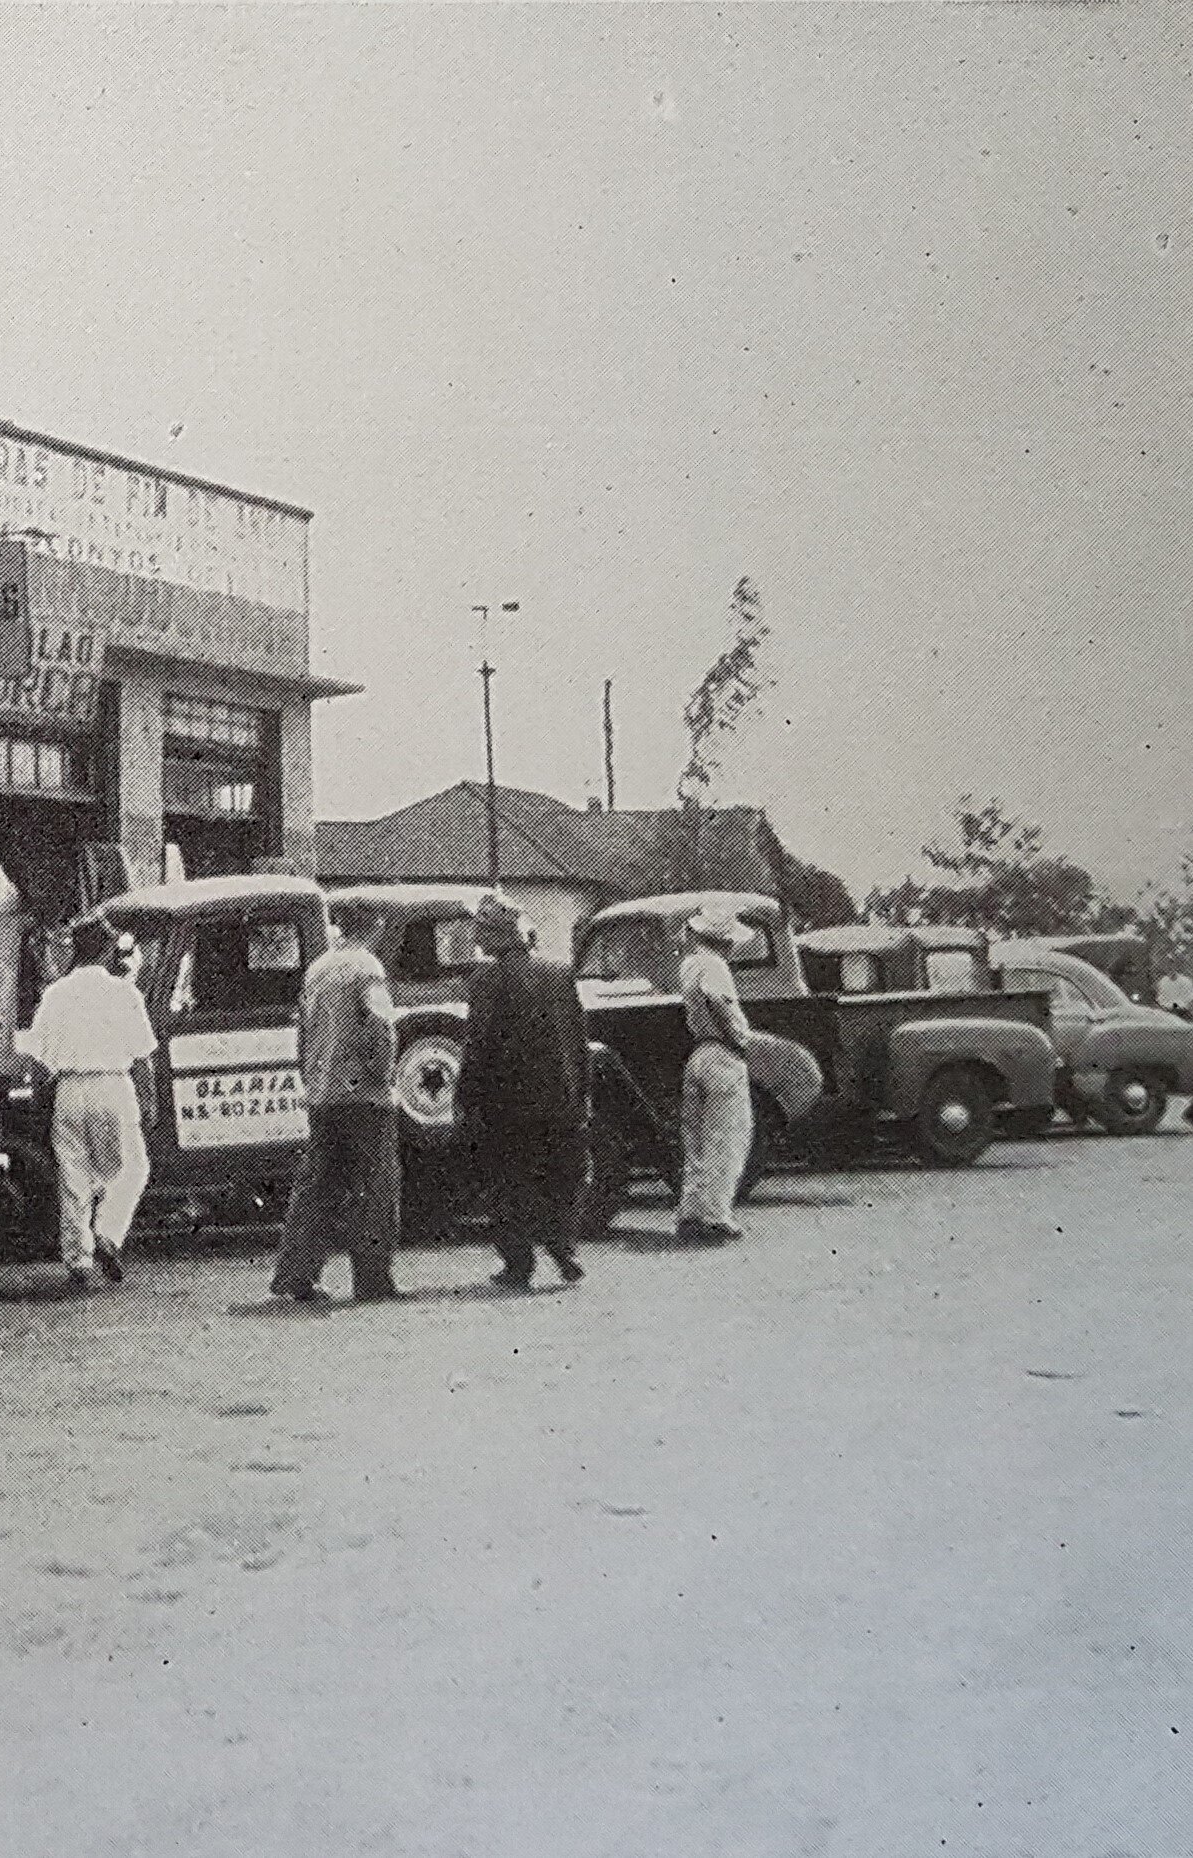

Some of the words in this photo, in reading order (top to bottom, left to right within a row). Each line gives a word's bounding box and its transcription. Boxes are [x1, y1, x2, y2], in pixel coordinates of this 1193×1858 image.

[71, 458, 106, 507] DE
[124, 471, 169, 521] FIM
[196, 1074, 297, 1100] OLARIA
